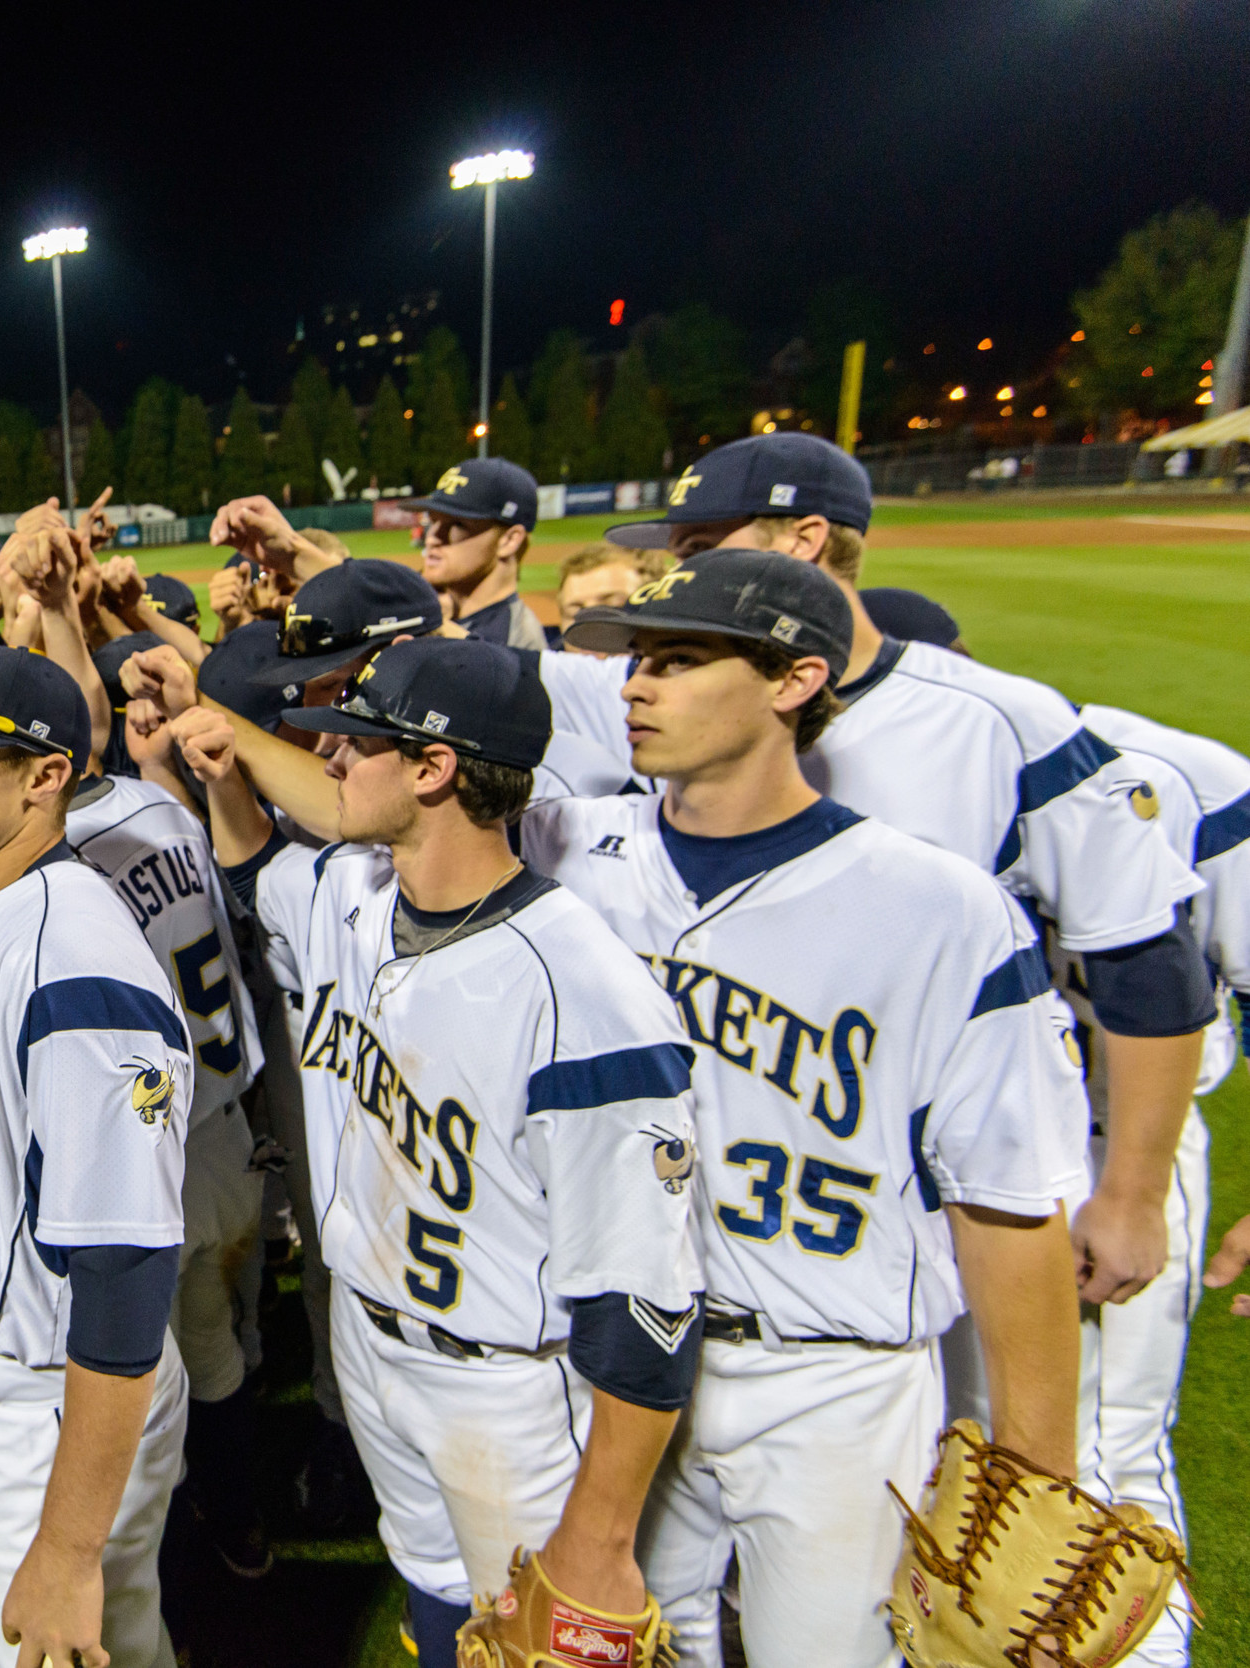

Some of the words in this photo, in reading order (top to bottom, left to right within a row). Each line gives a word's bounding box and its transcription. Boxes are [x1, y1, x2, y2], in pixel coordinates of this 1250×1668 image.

[116, 843, 205, 934] USTUS
[170, 927, 243, 1079] 5
[636, 952, 879, 1141] KETS
[714, 1137, 881, 1260] 35
[402, 1207, 465, 1315] 5
[556, 1626, 627, 1662] Rawlings
